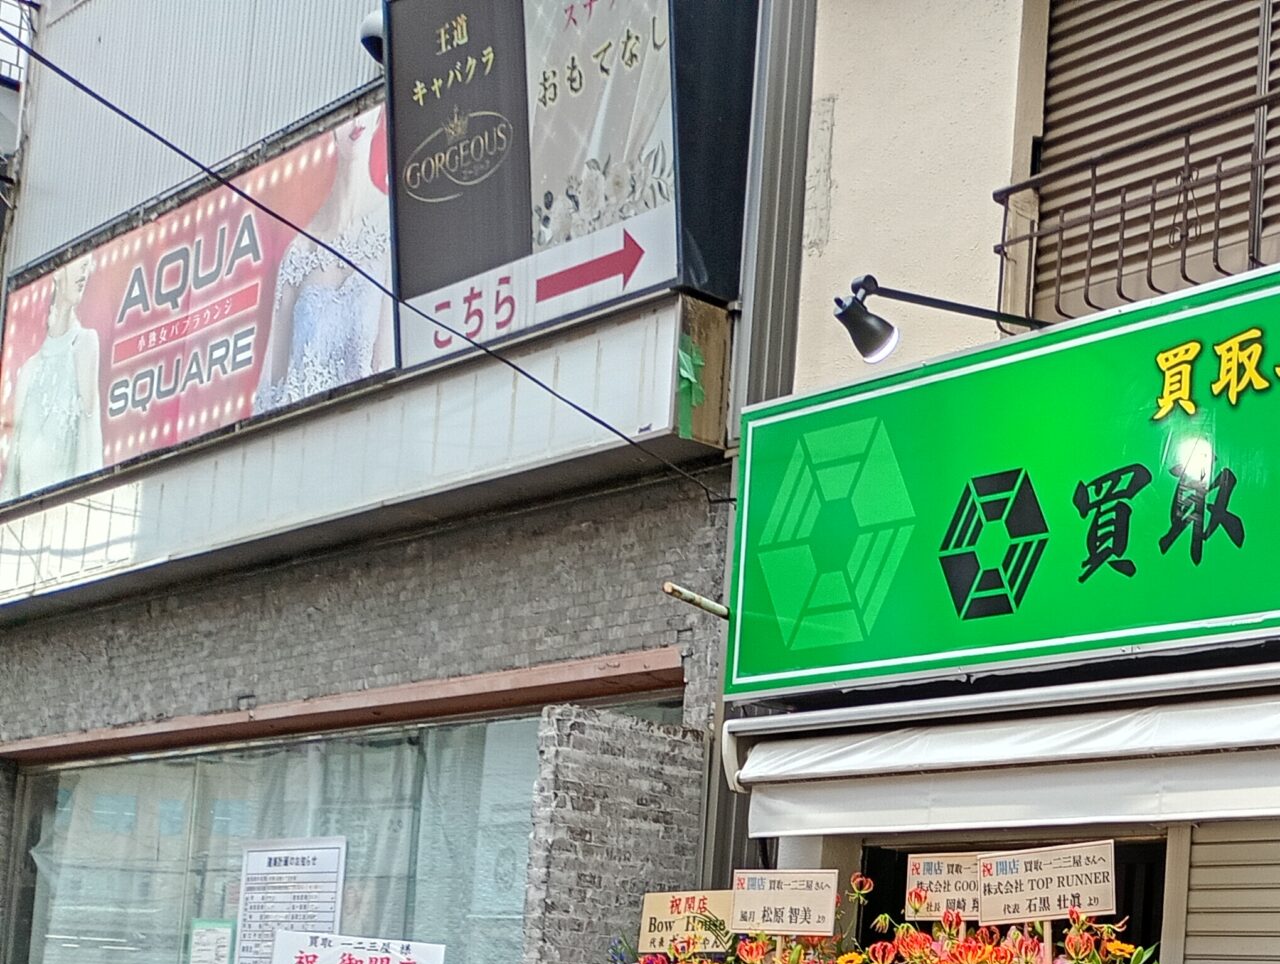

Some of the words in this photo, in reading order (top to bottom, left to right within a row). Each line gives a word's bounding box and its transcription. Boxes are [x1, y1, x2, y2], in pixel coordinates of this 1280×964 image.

[436, 14, 468, 55] 王道
[563, 0, 615, 32] スナ
[413, 46, 494, 106] キャバクラ
[539, 16, 666, 107] おもてなし
[407, 124, 507, 189] GORGEOUS
[116, 213, 261, 324] AQUA
[434, 276, 516, 349] こちら
[109, 327, 256, 417] SQUARE
[983, 879, 1024, 896] 株式会社
[1028, 877, 1053, 891] TOP
[1057, 871, 1110, 888] RUNNER
[1003, 903, 1020, 915] 代表
[648, 917, 675, 933] Bow
